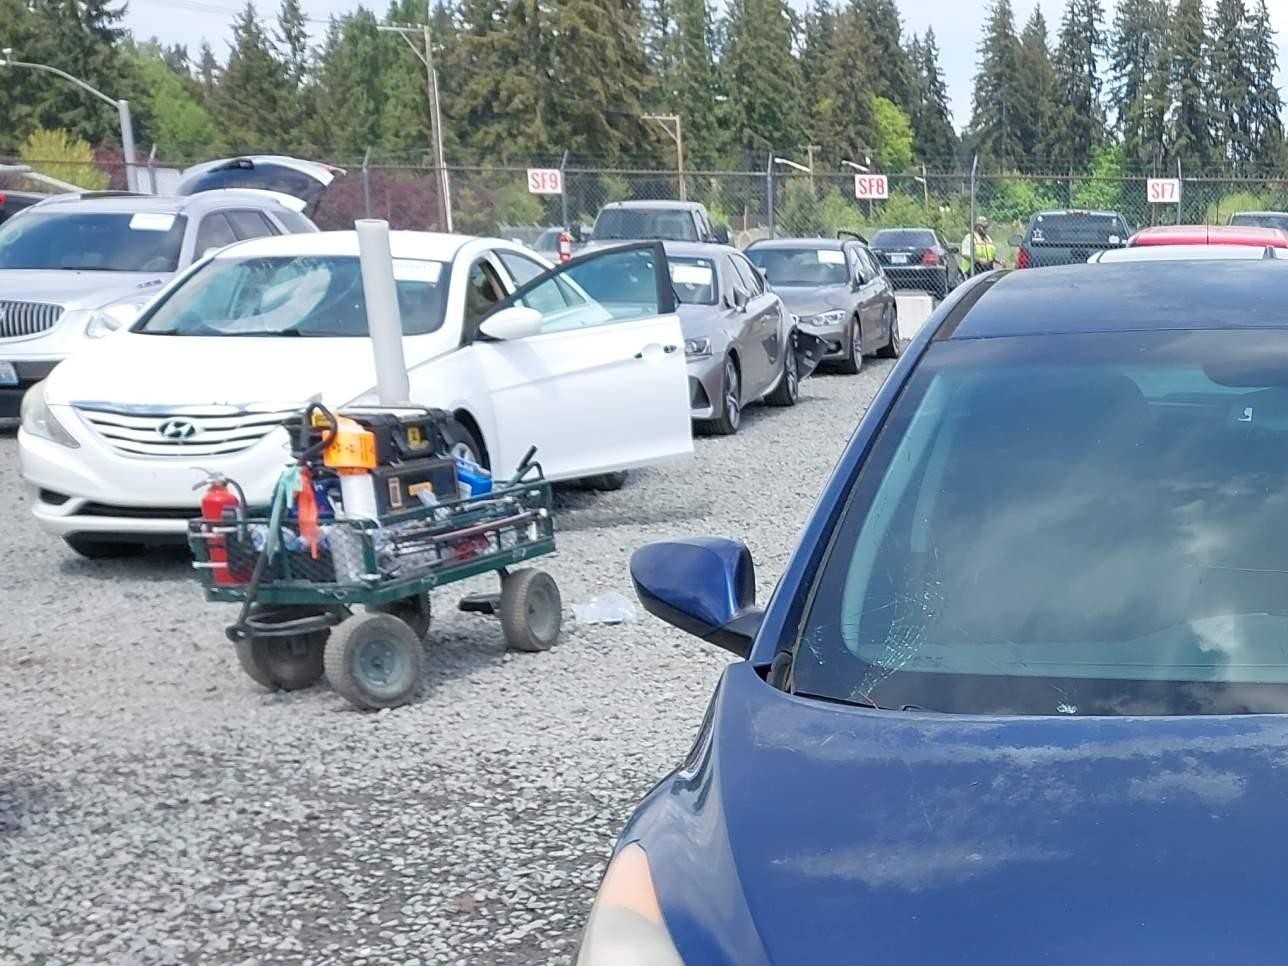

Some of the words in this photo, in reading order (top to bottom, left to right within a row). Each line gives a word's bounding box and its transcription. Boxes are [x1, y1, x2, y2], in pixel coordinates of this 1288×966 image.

[531, 172, 559, 190] SF9
[858, 177, 885, 195] SF8
[1151, 182, 1175, 199] SF7
